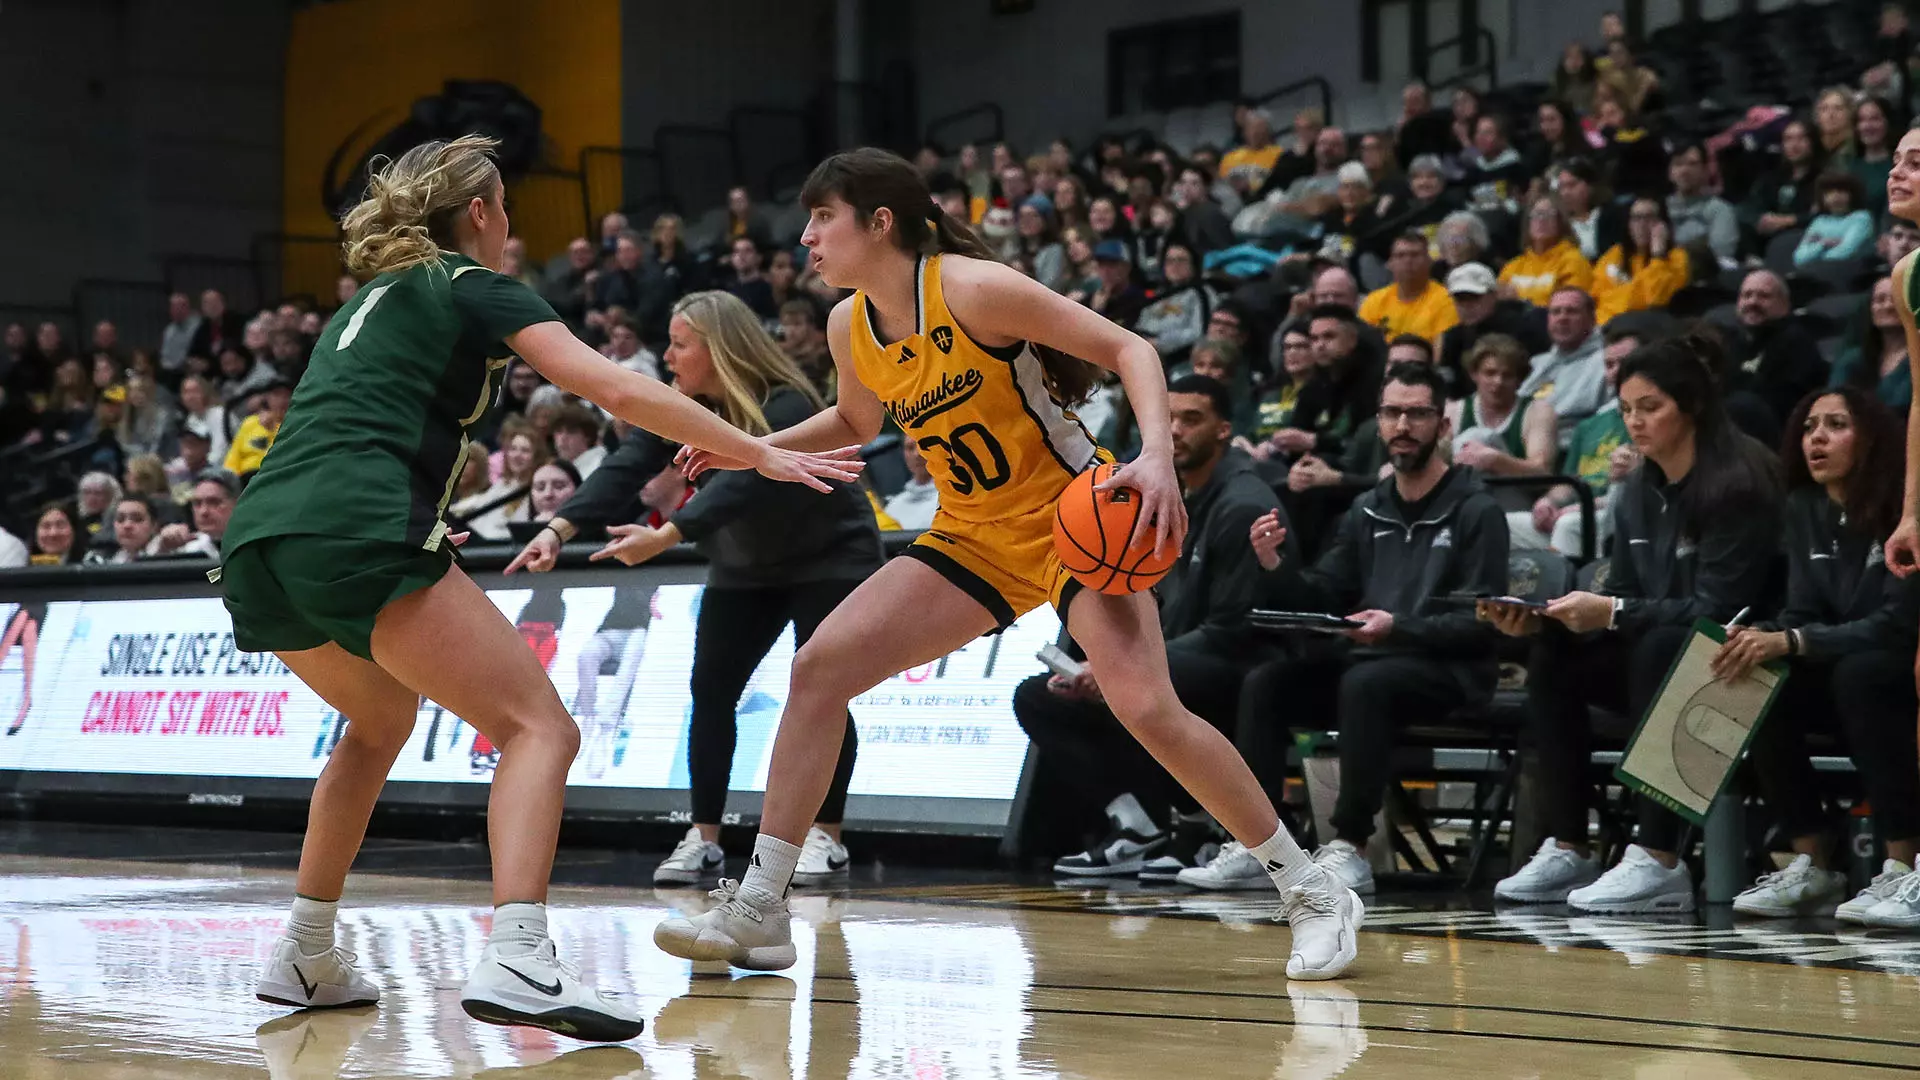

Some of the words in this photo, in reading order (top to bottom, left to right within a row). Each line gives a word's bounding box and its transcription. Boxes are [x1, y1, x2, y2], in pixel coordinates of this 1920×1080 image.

[336, 280, 398, 351] 1
[883, 368, 983, 428] Milwaukee
[917, 422, 1011, 496] 30
[101, 632, 176, 676] SINGLE
[171, 632, 217, 676] USE
[81, 690, 167, 734] CANNOT
[161, 690, 202, 735] SIT
[196, 690, 257, 735] WITH
[1853, 833, 1873, 857] G
